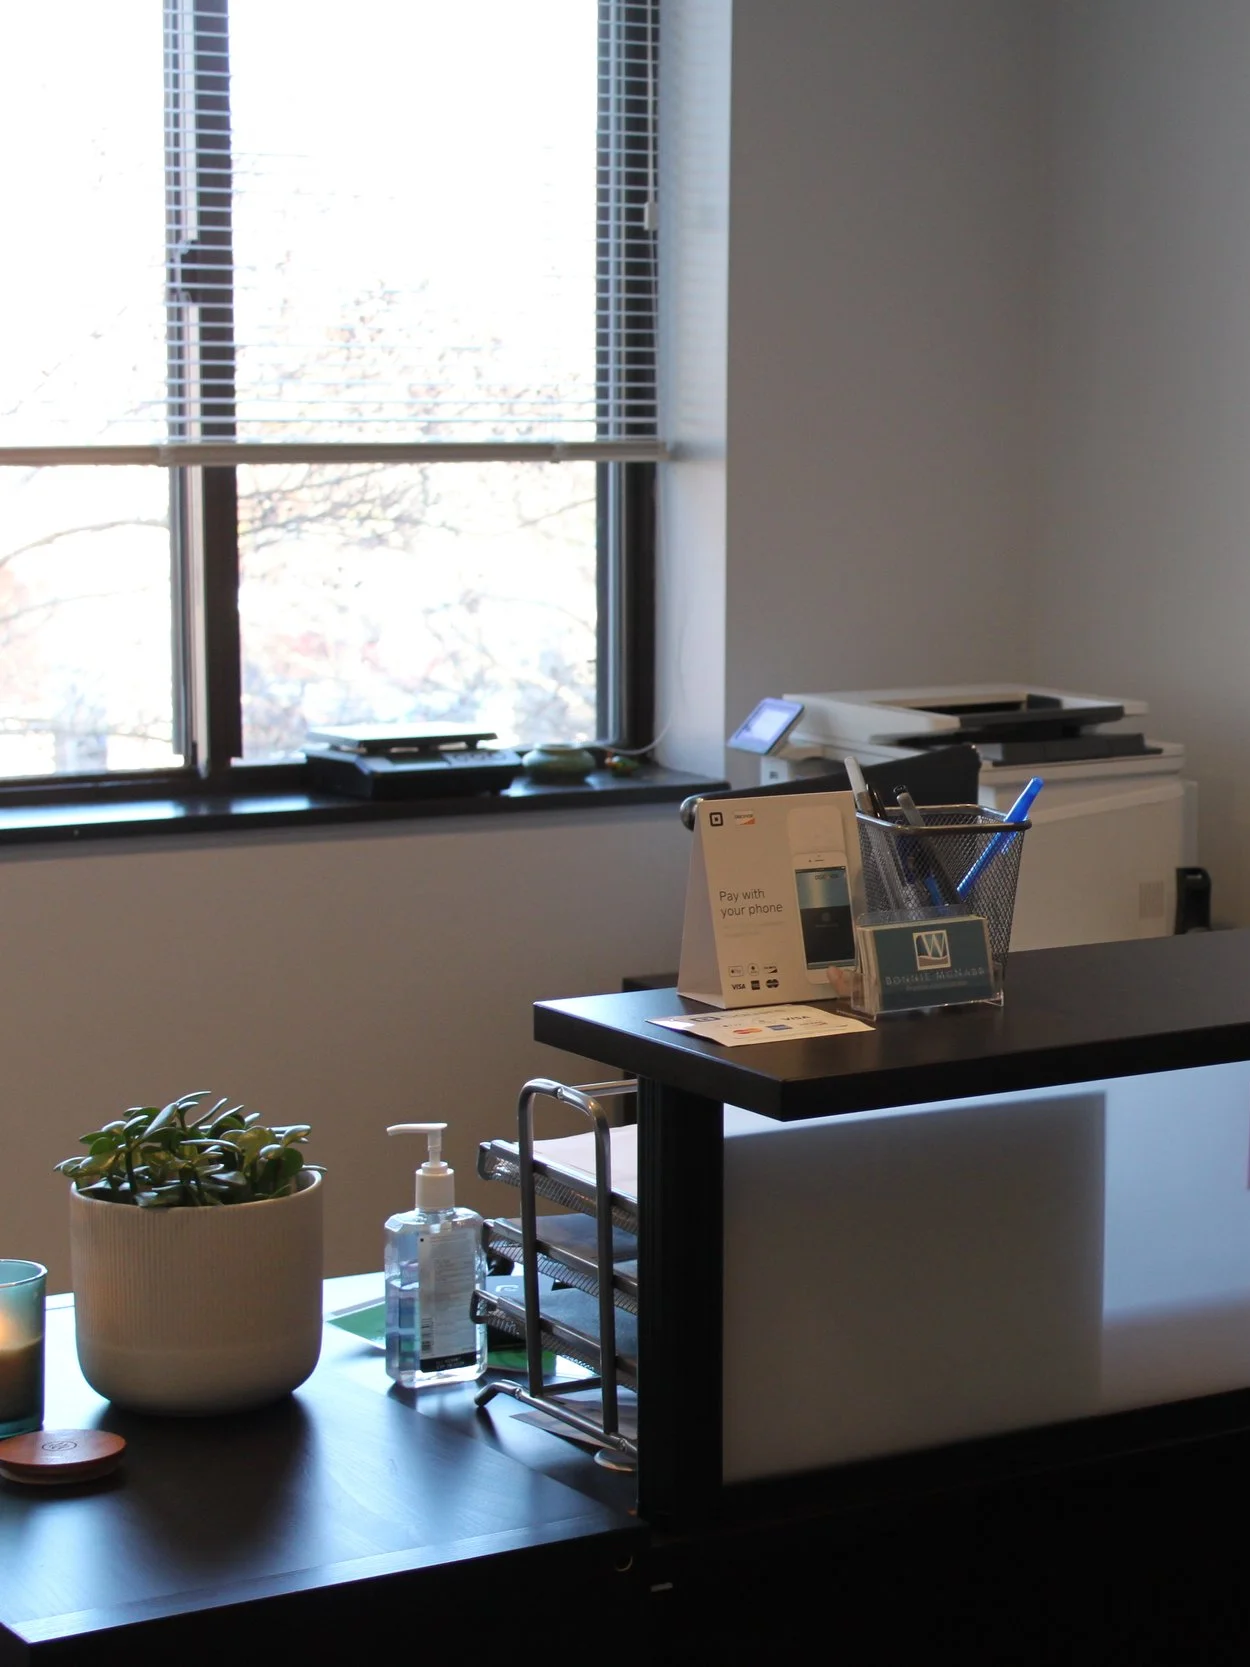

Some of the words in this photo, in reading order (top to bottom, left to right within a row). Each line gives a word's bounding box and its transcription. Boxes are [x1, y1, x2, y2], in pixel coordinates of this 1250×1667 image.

[719, 890, 739, 902] Pay
[742, 888, 766, 901] with
[720, 906, 745, 919] your
[748, 903, 784, 916] phone
